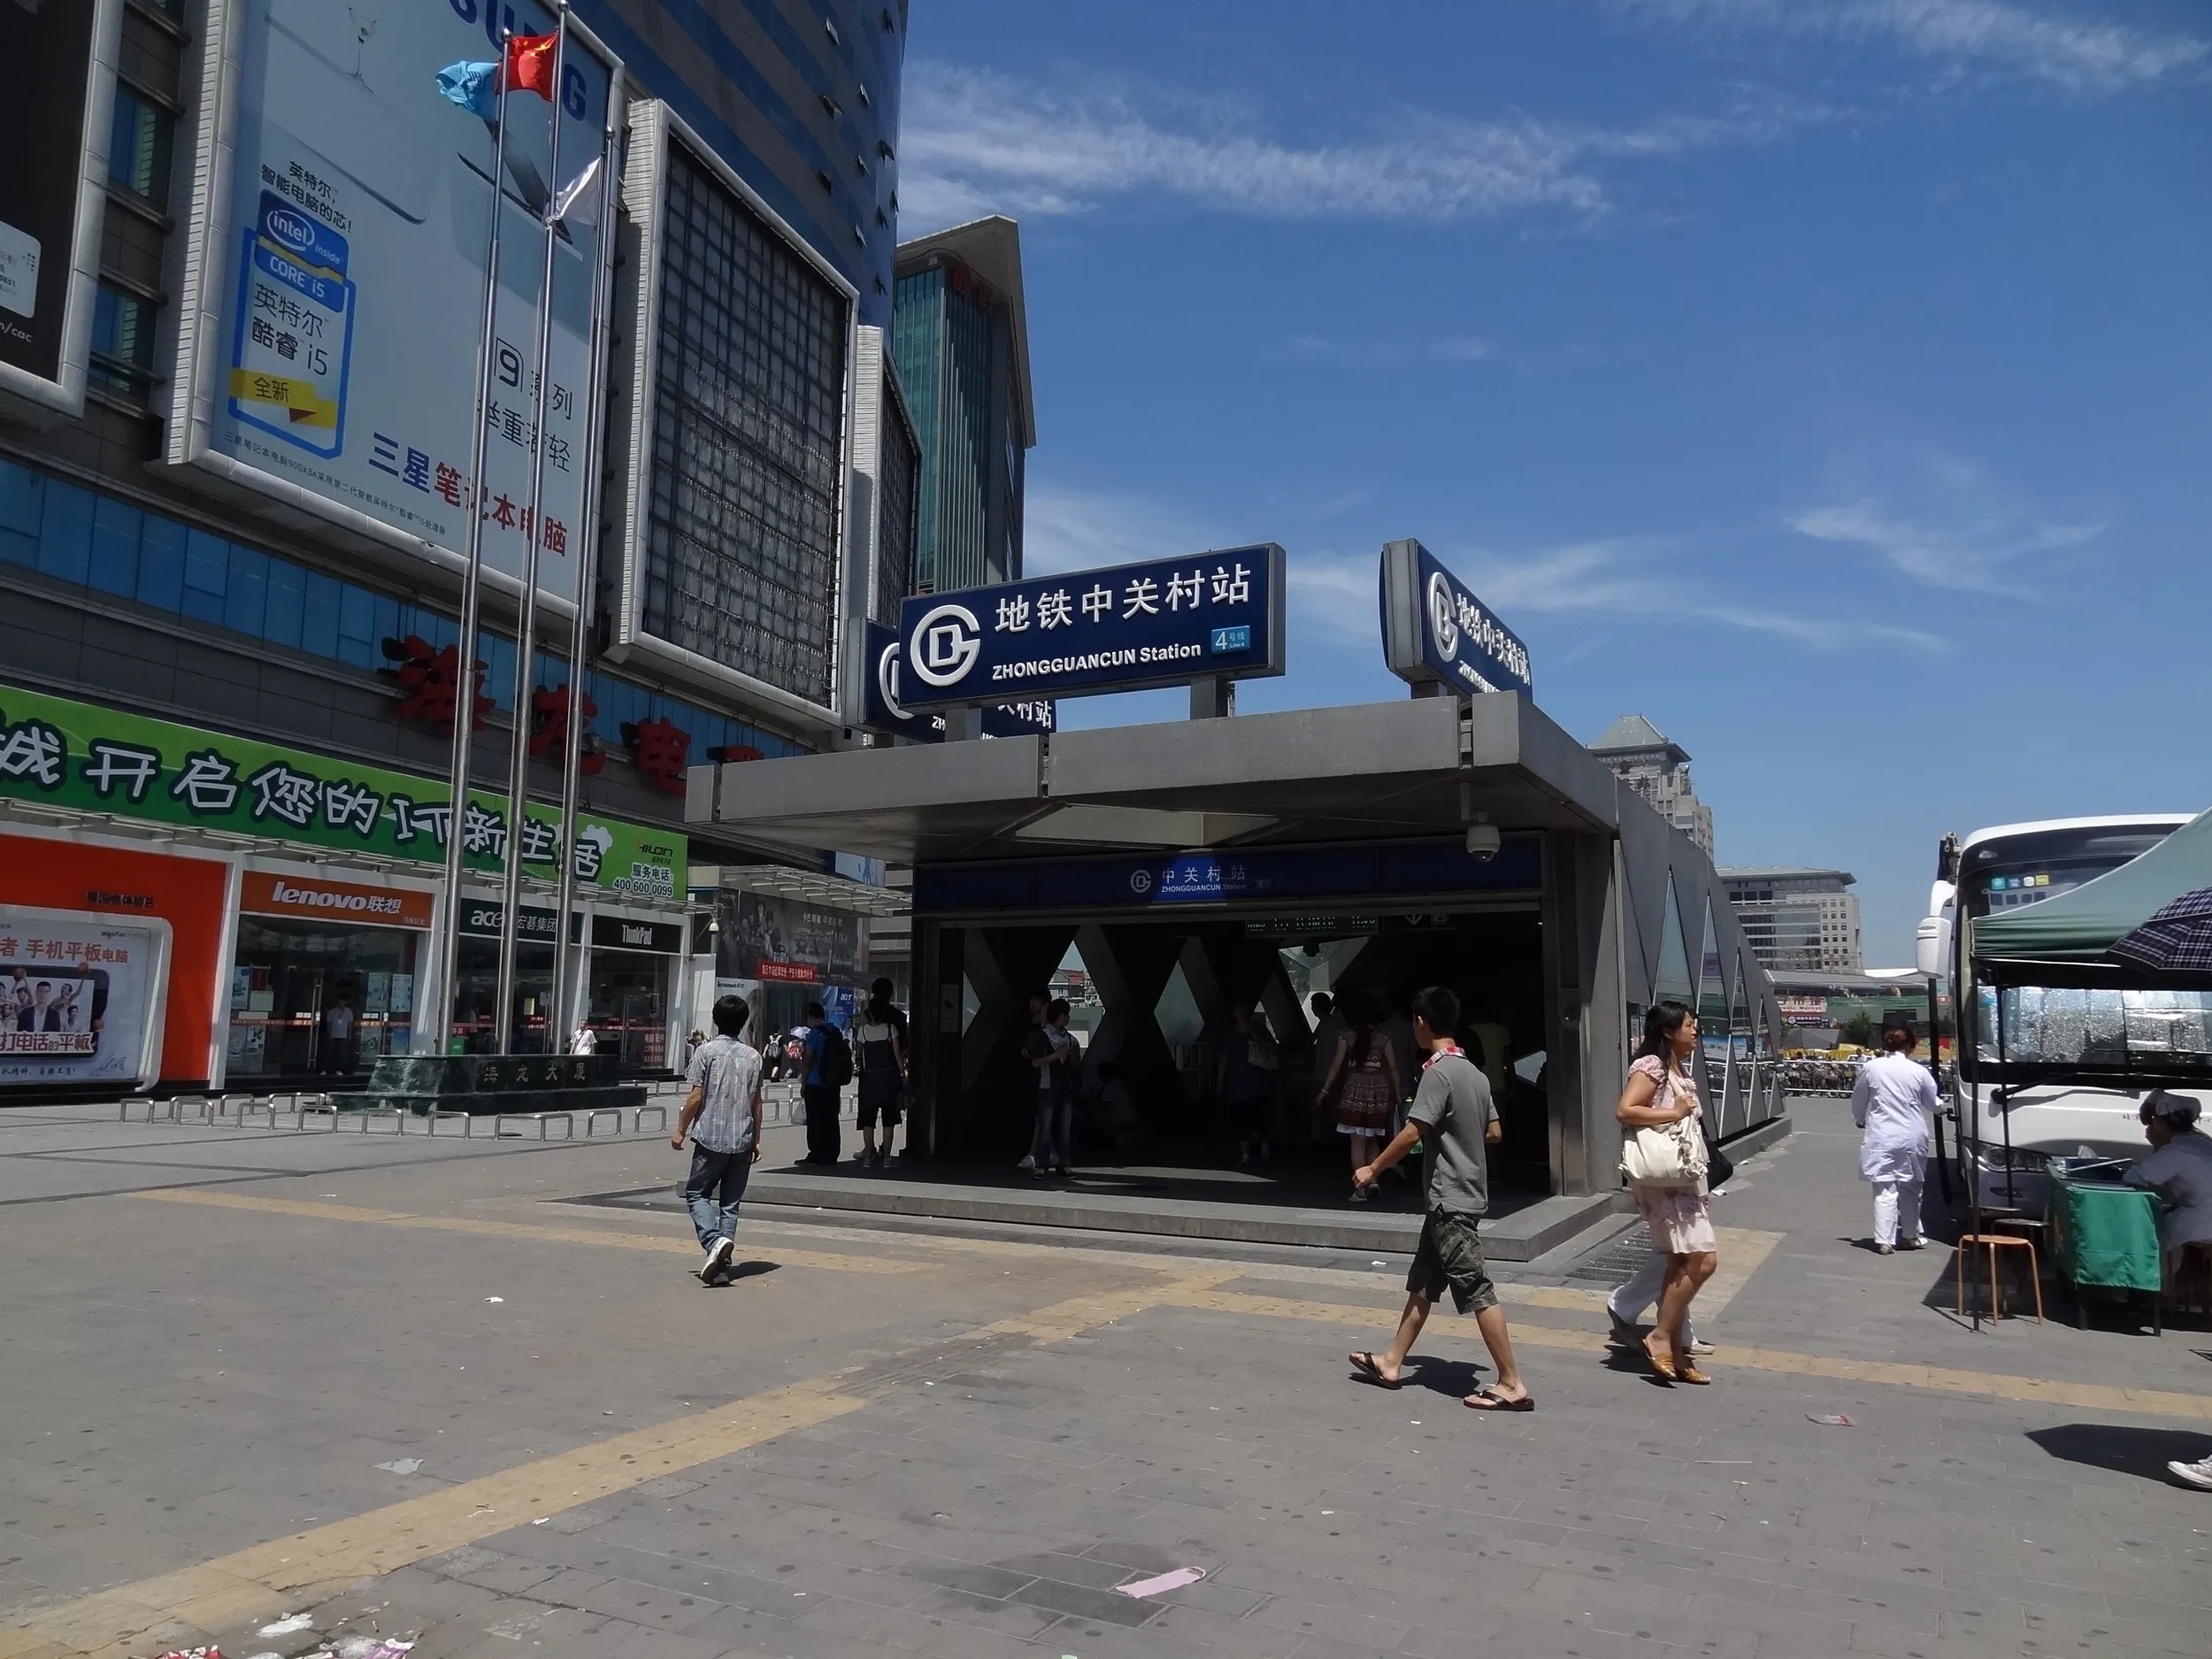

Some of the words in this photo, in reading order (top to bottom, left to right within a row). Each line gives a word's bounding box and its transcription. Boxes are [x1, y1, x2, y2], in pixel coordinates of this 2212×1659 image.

[273, 211, 307, 244] intel
[270, 256, 305, 288] CORE
[311, 279, 325, 298] i5
[308, 344, 328, 375] i5
[254, 377, 289, 402] 全新
[995, 563, 1251, 633] 地铁中关村站
[1215, 631, 1228, 650] 4
[992, 647, 1136, 680] ZHONGGUANCUN
[1140, 642, 1202, 663] Station
[612, 877, 631, 891] 400
[634, 880, 649, 893] 600
[651, 884, 673, 897] 0099
[1162, 864, 1246, 884] 中关村站
[271, 881, 367, 910] lenovo
[1161, 883, 1221, 893] ZHONGGUANCUN
[621, 924, 653, 946] ThinkPad
[26, 938, 129, 964] 手机平板电脑
